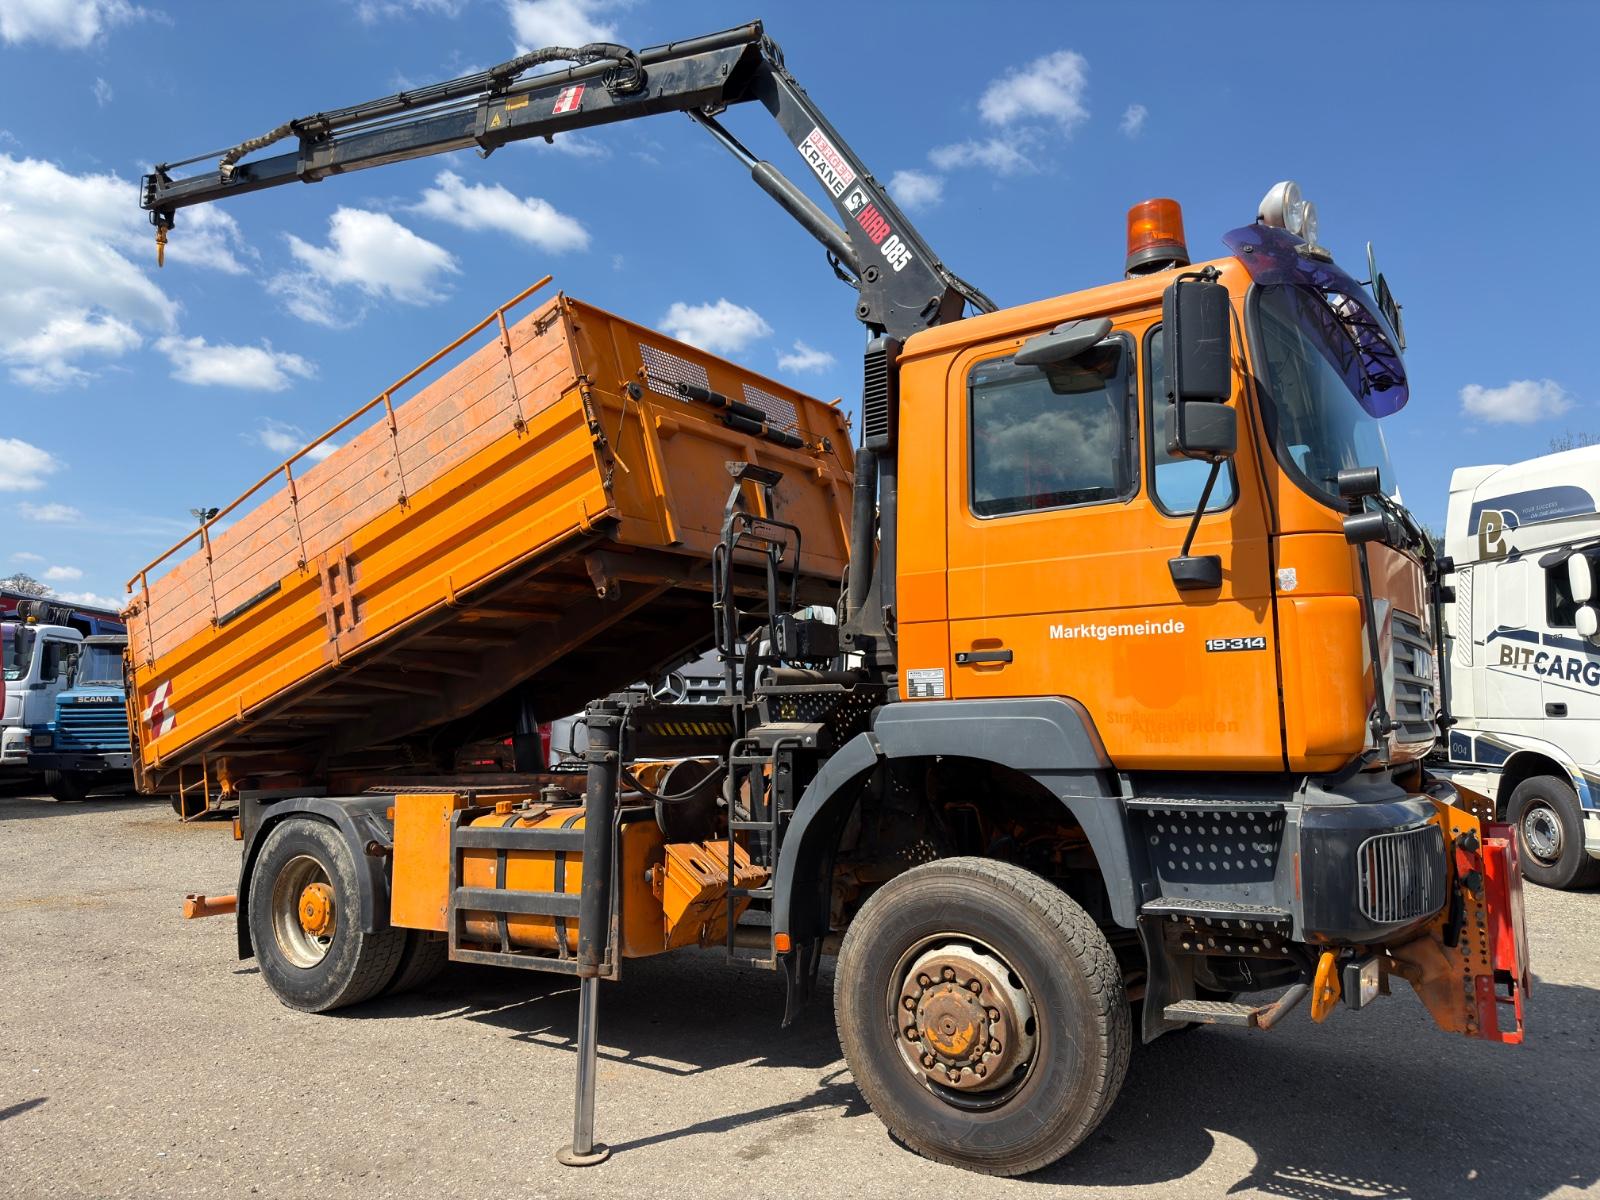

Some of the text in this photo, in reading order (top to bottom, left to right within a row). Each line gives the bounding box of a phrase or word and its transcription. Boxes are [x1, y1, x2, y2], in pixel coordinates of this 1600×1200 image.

[800, 140, 845, 195] KRÄNE
[809, 130, 855, 185] BERGER
[855, 203, 913, 272] HIAB 085
[1049, 619, 1185, 641] Marktgemeinde
[1500, 643, 1600, 687] BITCARG
[1452, 742, 1467, 756] 004
